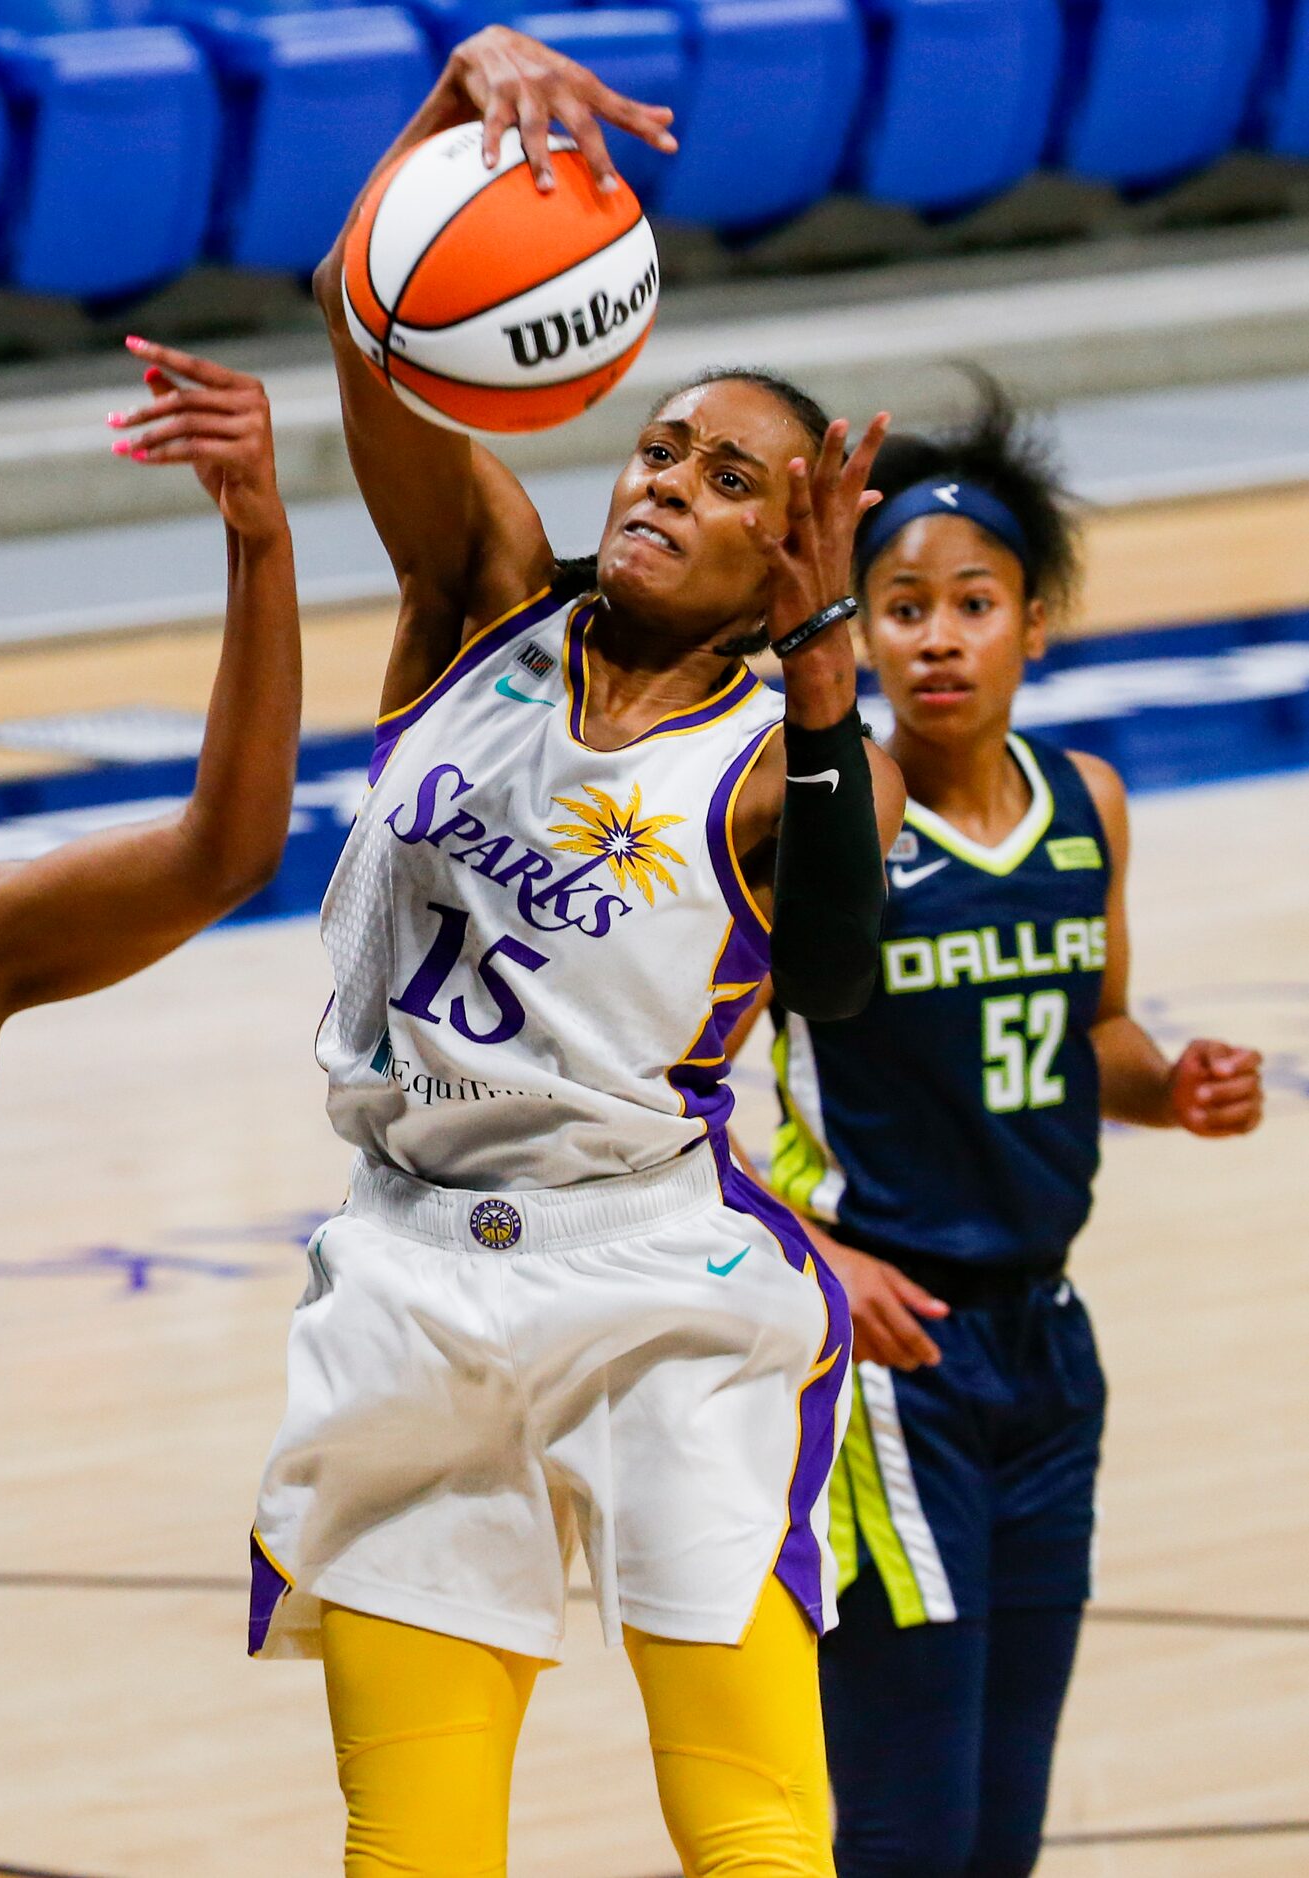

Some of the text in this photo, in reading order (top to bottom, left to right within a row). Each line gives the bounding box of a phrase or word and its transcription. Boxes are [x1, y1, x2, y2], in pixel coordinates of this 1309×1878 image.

[501, 261, 656, 367] Wilson
[384, 763, 633, 938] SPARKS
[389, 902, 550, 1044] 15
[982, 989, 1068, 1114] 52
